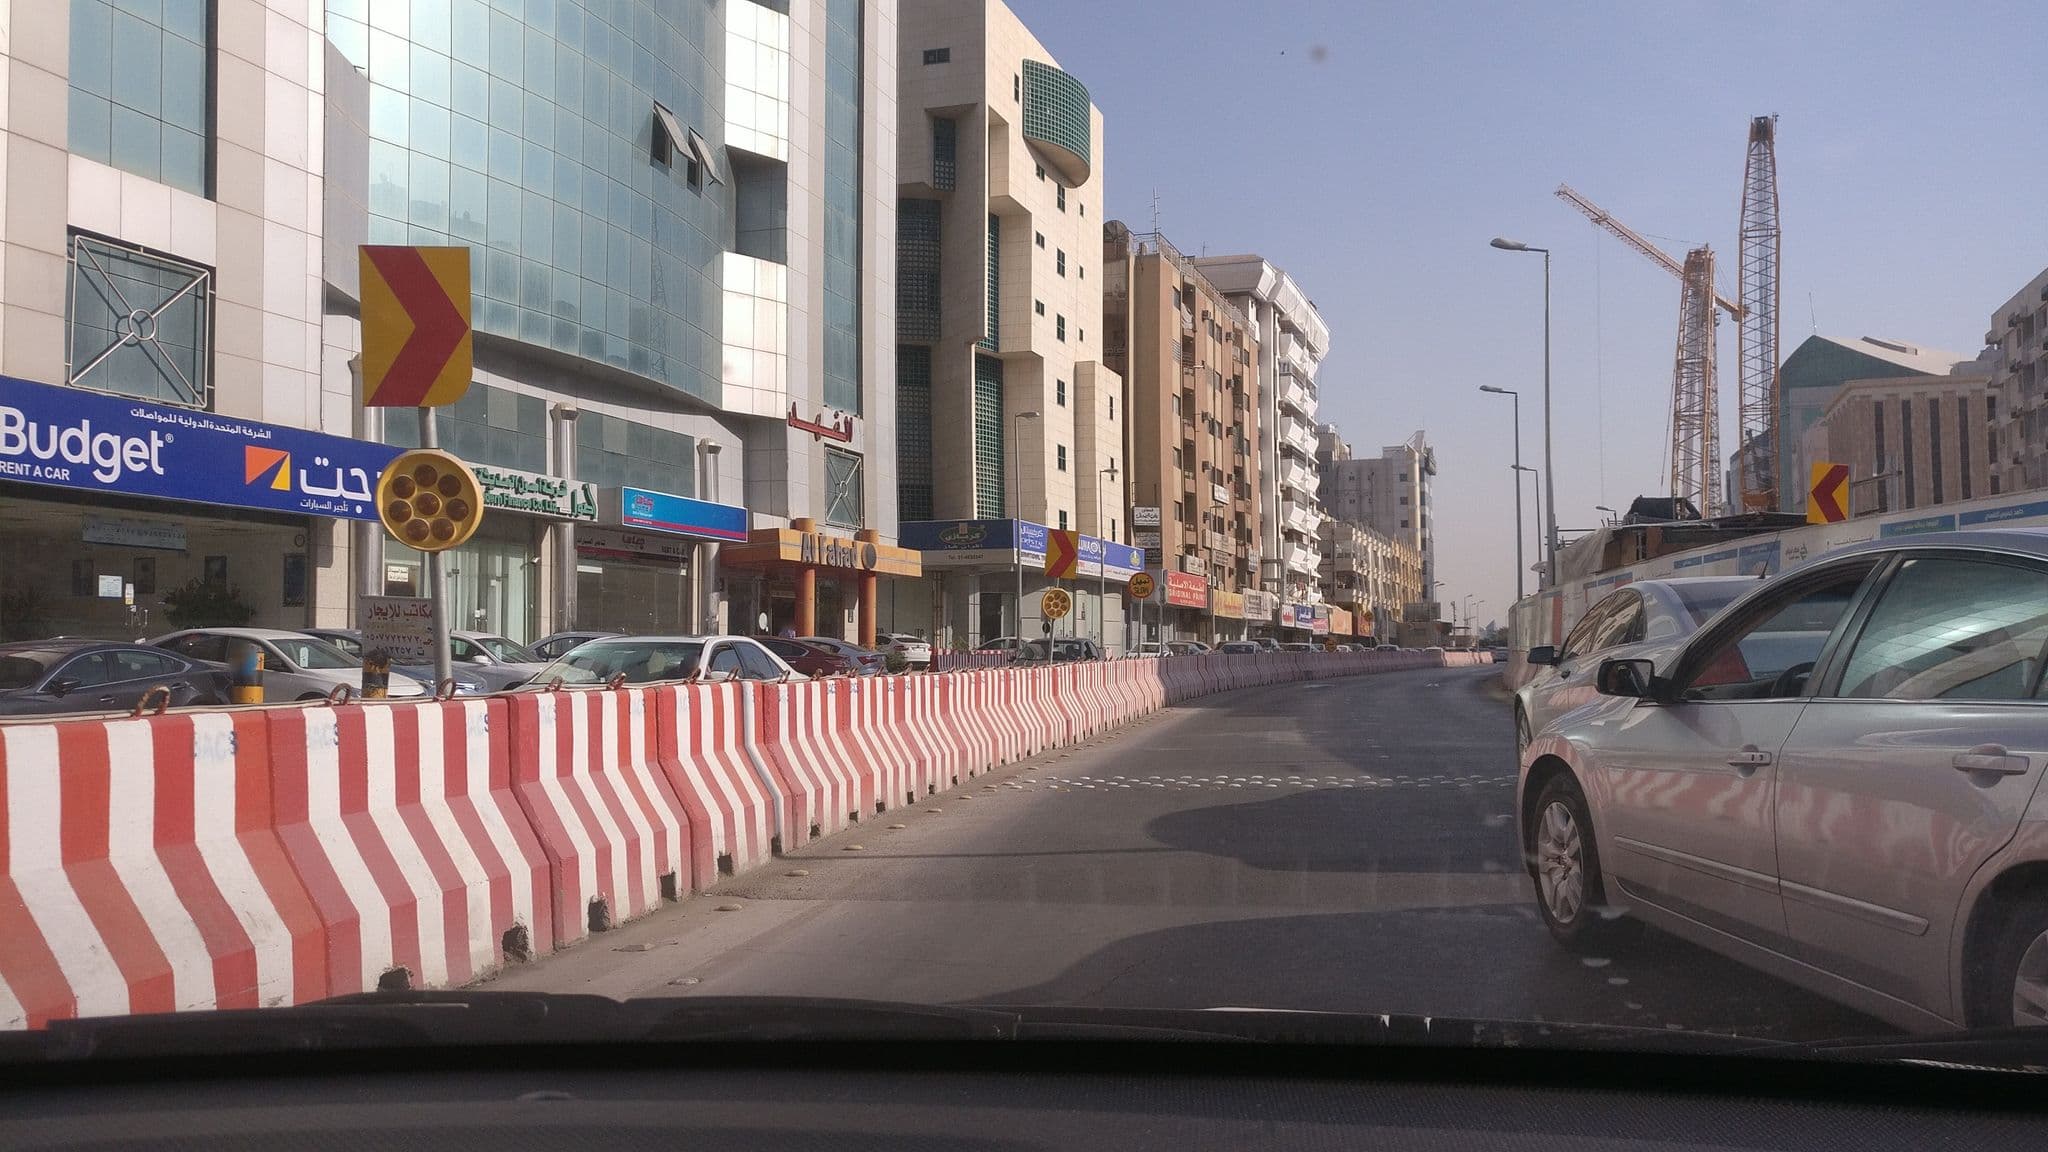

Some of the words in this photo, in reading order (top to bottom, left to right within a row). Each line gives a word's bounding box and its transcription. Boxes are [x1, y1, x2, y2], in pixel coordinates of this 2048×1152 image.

[130, 408, 177, 424] للمواصلات
[178, 415, 210, 429] الدولية
[209, 420, 242, 435] المتحدة
[242, 424, 272, 440] الشركة
[0, 405, 164, 484] Budget
[33, 467, 43, 478] A
[44, 467, 70, 481] CAR
[300, 498, 332, 511] السيارات
[818, 535, 858, 569] Fahad
